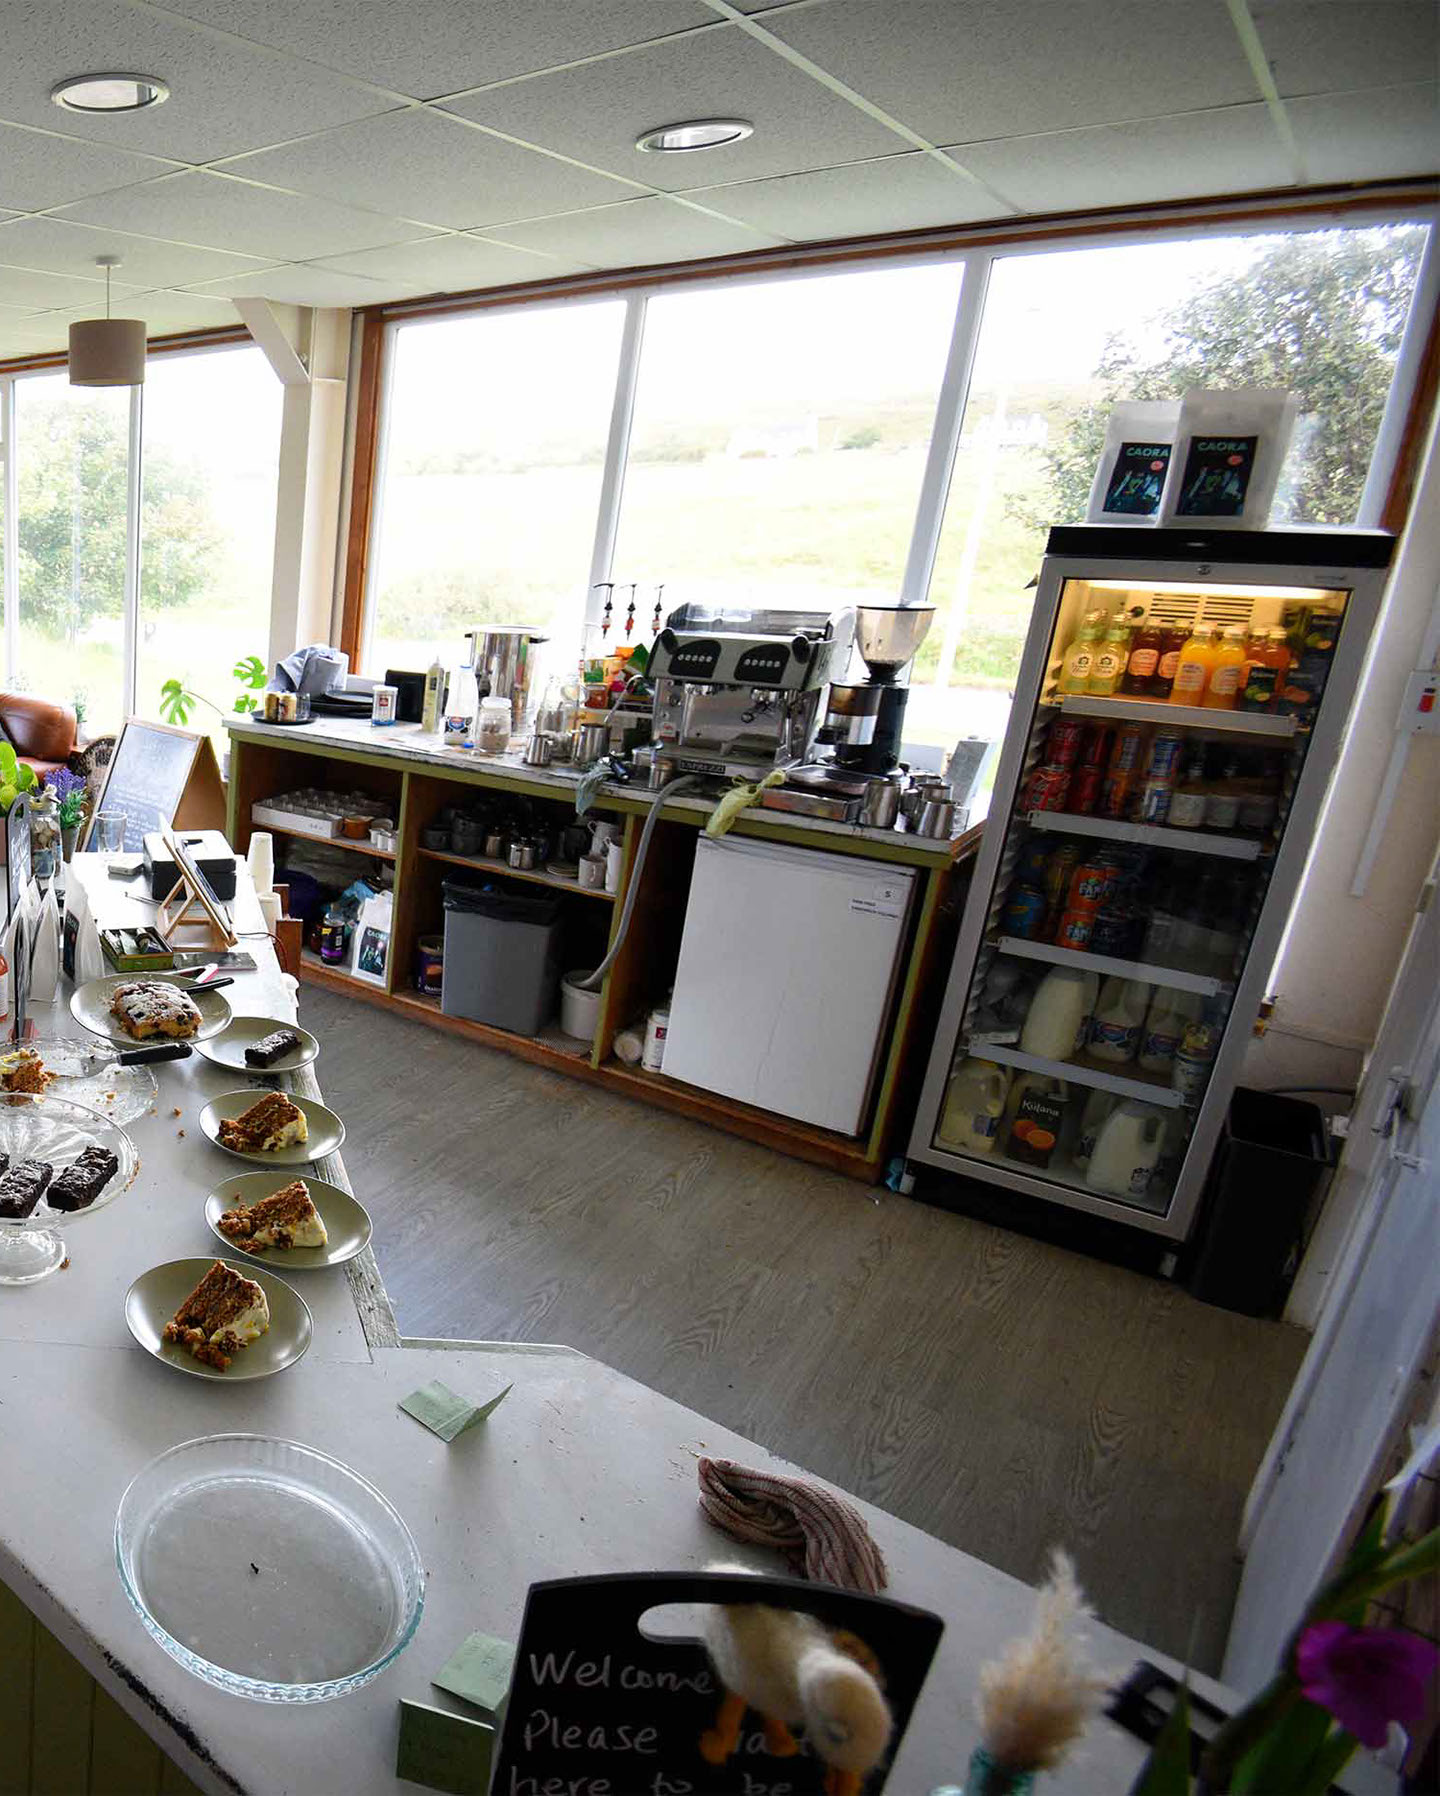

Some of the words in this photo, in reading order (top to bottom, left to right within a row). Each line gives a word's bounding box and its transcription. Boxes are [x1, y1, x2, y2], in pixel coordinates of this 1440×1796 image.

[1126, 447, 1169, 458] CAORA
[528, 1651, 715, 1693] Welcome
[524, 1709, 658, 1756] Please
[510, 1766, 612, 1796] here
[651, 1770, 695, 1796] to
[744, 1763, 793, 1796] be
